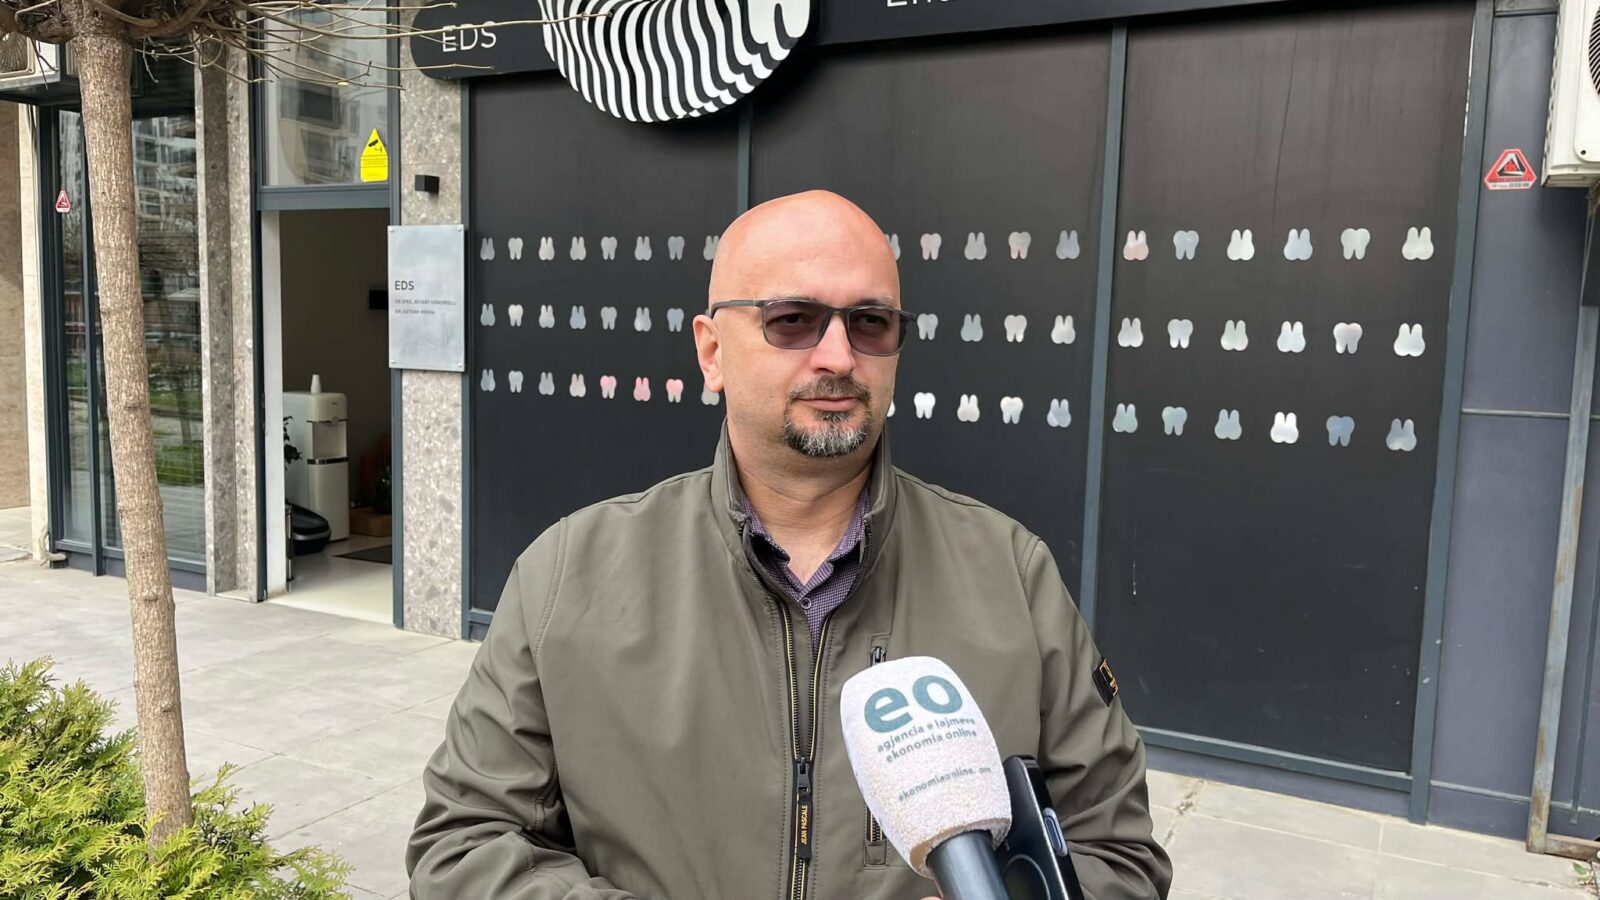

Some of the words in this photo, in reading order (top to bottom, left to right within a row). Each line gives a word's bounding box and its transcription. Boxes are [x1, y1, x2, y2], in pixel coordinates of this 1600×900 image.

[442, 20, 497, 53] EDS
[394, 280, 415, 291] EDS
[864, 675, 963, 733] eo
[877, 725, 925, 753] agjencia
[886, 733, 943, 763] ekonomia
[945, 729, 977, 740] online
